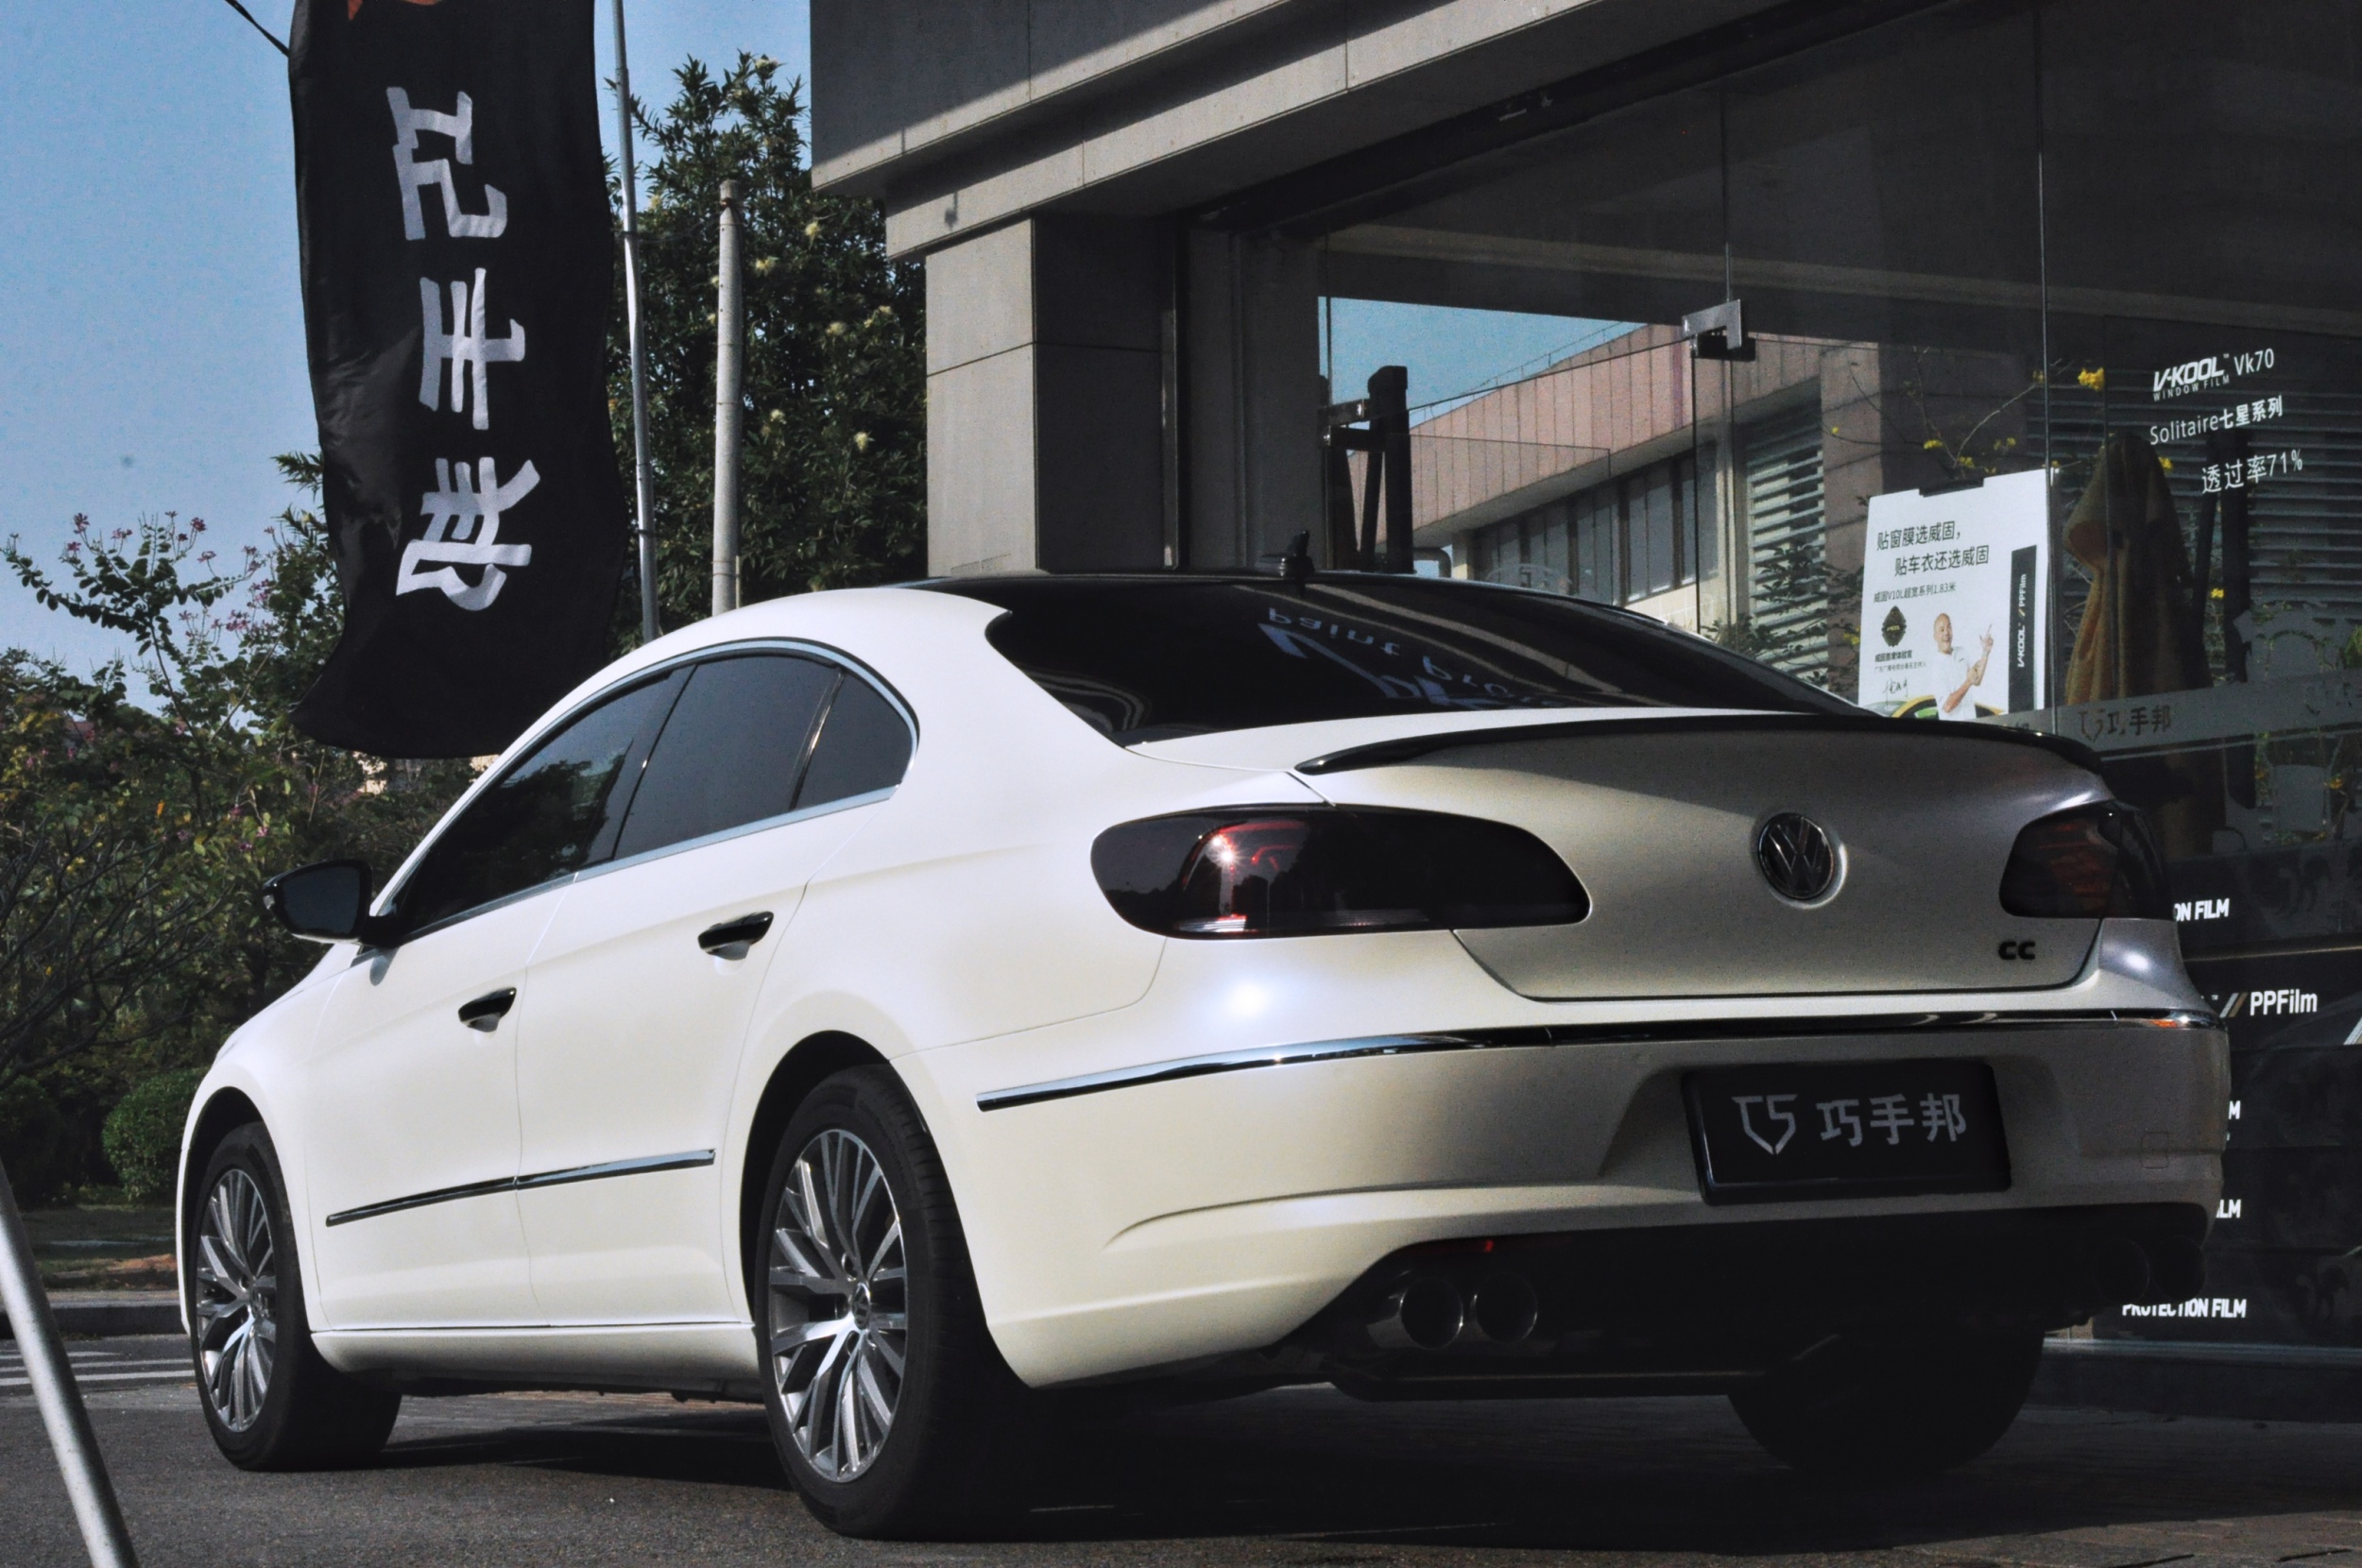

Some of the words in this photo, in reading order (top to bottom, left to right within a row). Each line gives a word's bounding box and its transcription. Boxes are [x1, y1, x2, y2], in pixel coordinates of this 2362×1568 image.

[2153, 356, 2225, 392] V-KOOL
[2234, 348, 2275, 376] Vk70
[2153, 383, 2199, 401] WINDOW
[2203, 375, 2230, 388] FILM
[2202, 449, 2303, 494] 透过率71%
[1894, 545, 1990, 577] 贴车衣还选威固
[2194, 898, 2230, 920] FILM
[2250, 989, 2318, 1016] PPFilm
[1816, 1093, 1967, 1147] 巧手邦
[2212, 1299, 2247, 1318] FILM
